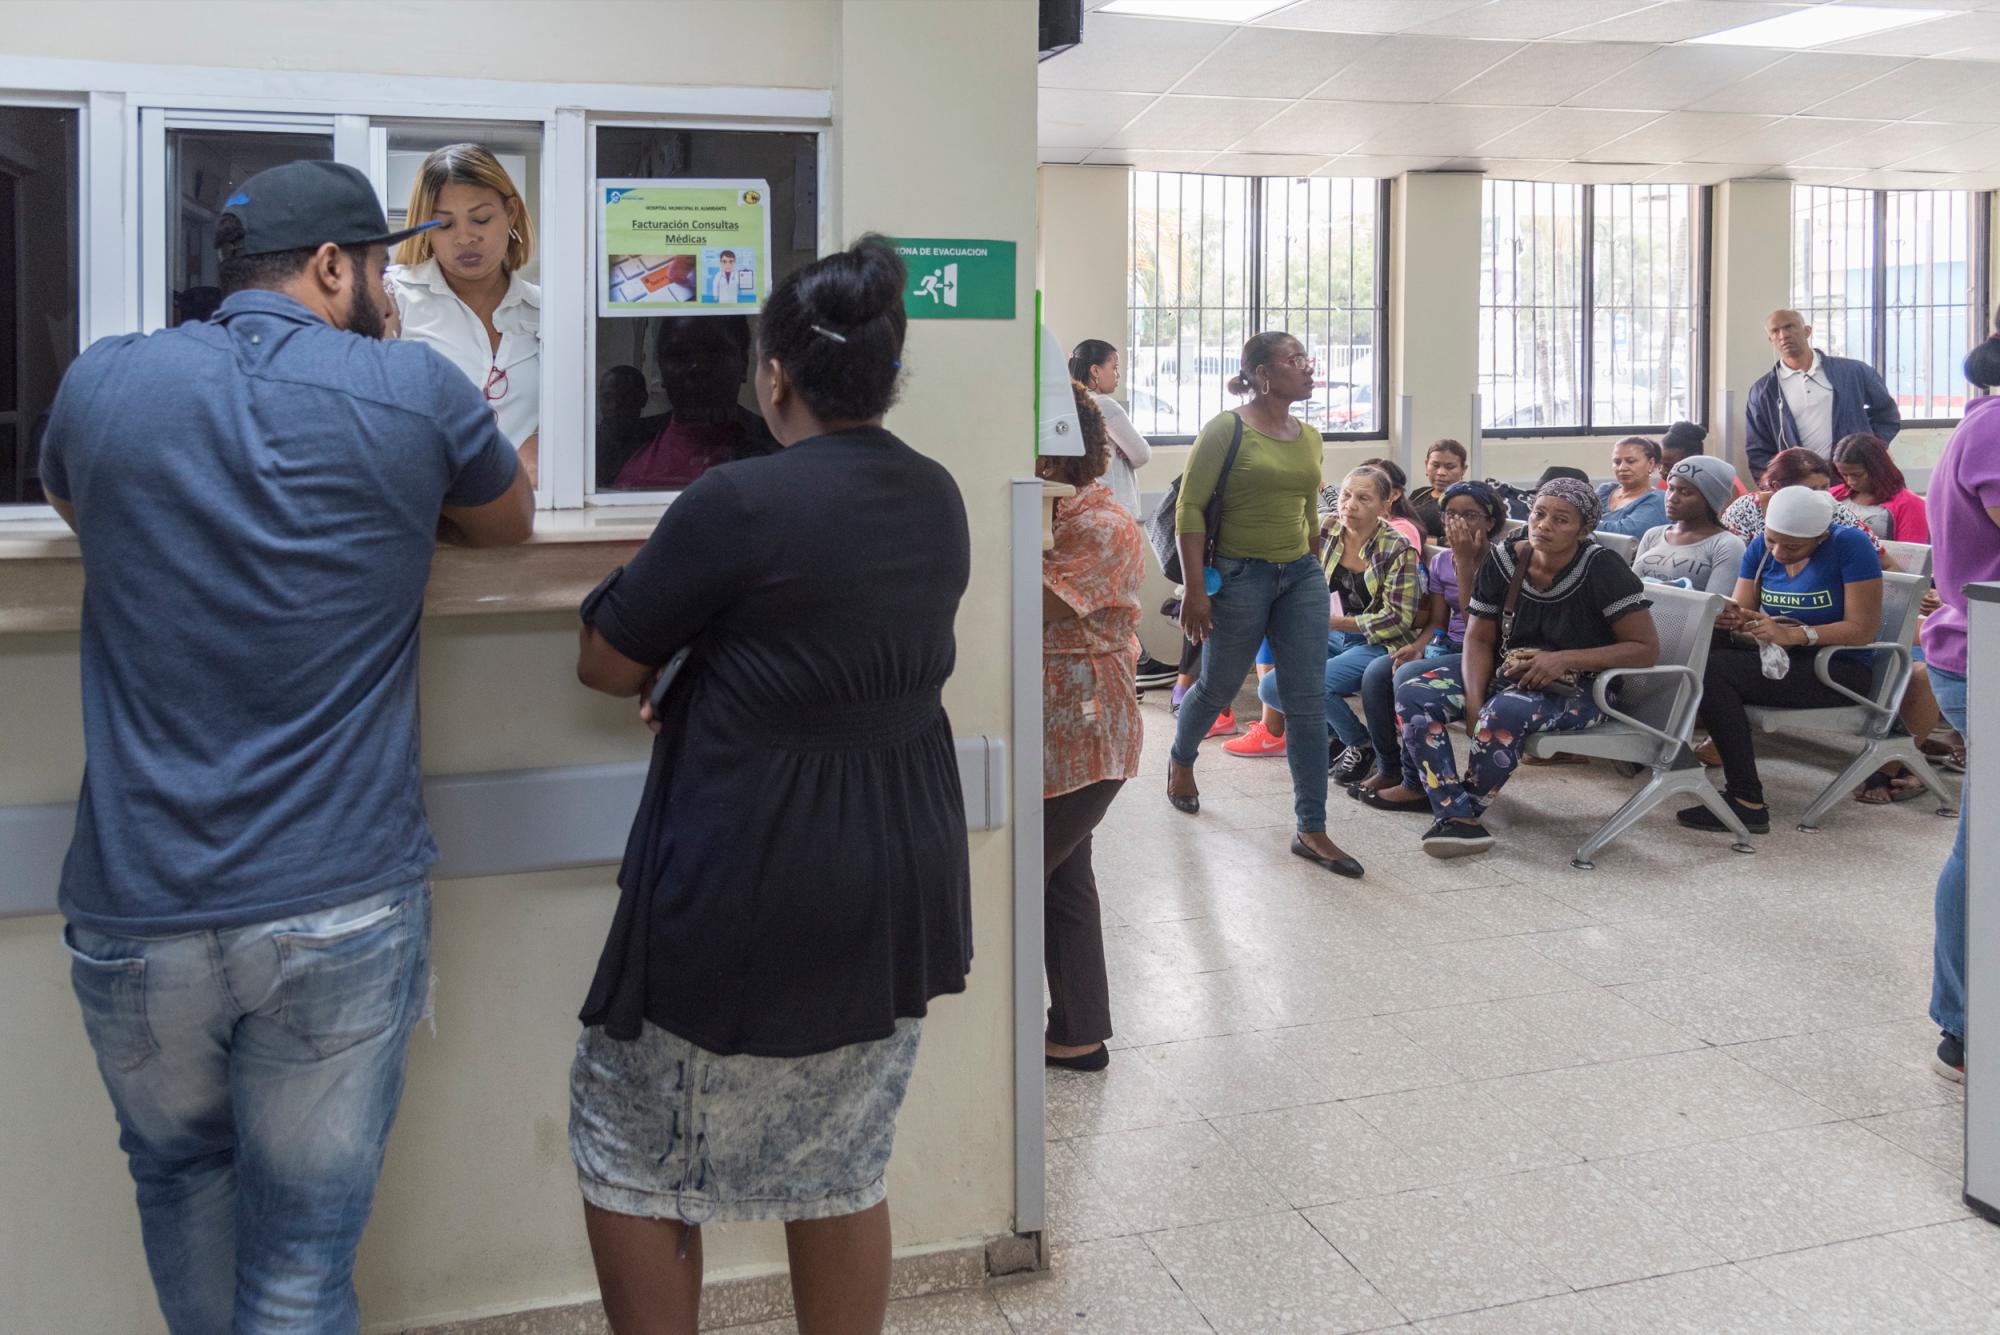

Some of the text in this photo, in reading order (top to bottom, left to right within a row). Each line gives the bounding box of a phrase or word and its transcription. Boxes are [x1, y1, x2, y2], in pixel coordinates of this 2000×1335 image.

[632, 219, 739, 230] Facturación Consultas
[665, 234, 707, 243] Médicas
[920, 247, 931, 256] DE
[933, 247, 988, 257] EVACUACION
[1813, 596, 1824, 605] IT
